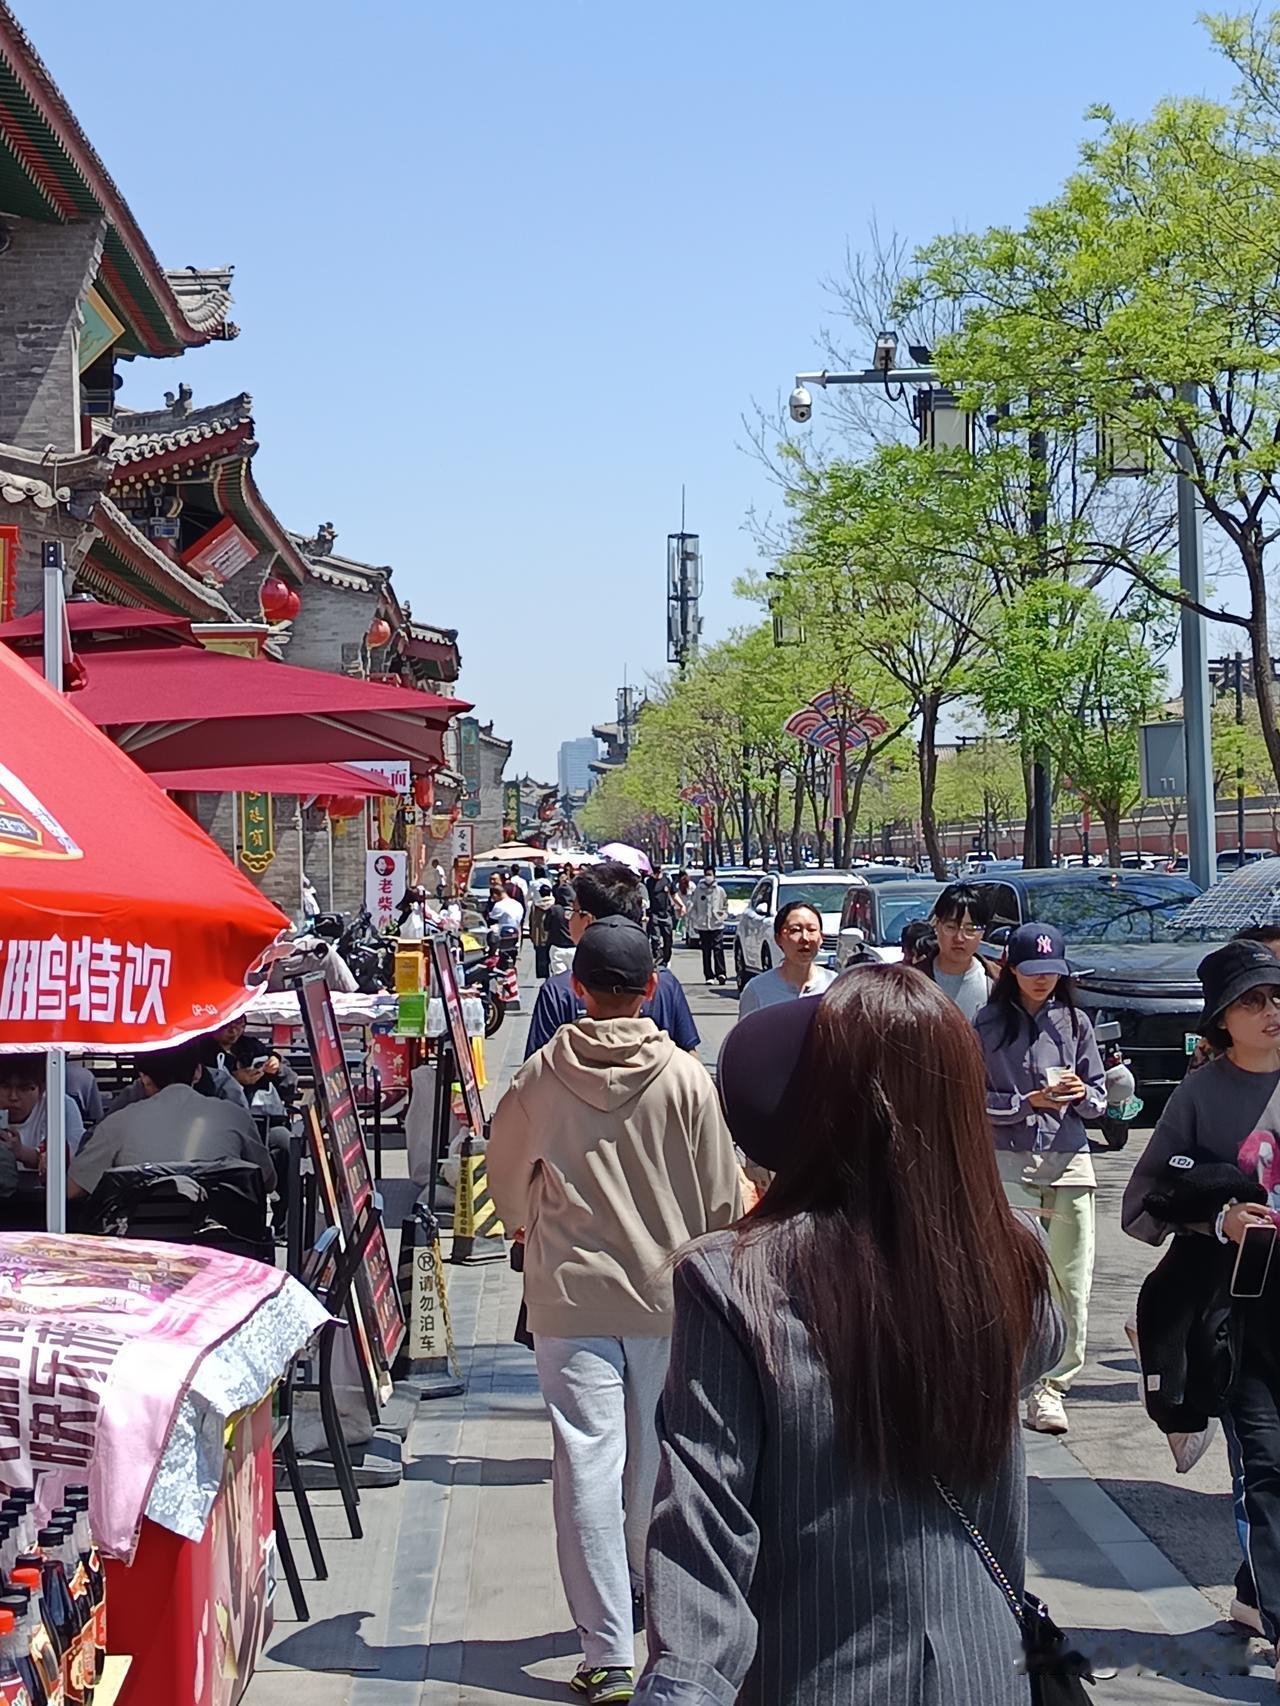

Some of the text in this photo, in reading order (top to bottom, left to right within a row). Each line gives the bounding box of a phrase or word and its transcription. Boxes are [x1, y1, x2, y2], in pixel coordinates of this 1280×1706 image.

[0, 933, 171, 1025] 鹏特饮
[1036, 935, 1052, 953] NY
[419, 1275, 436, 1352] 请勿泊车
